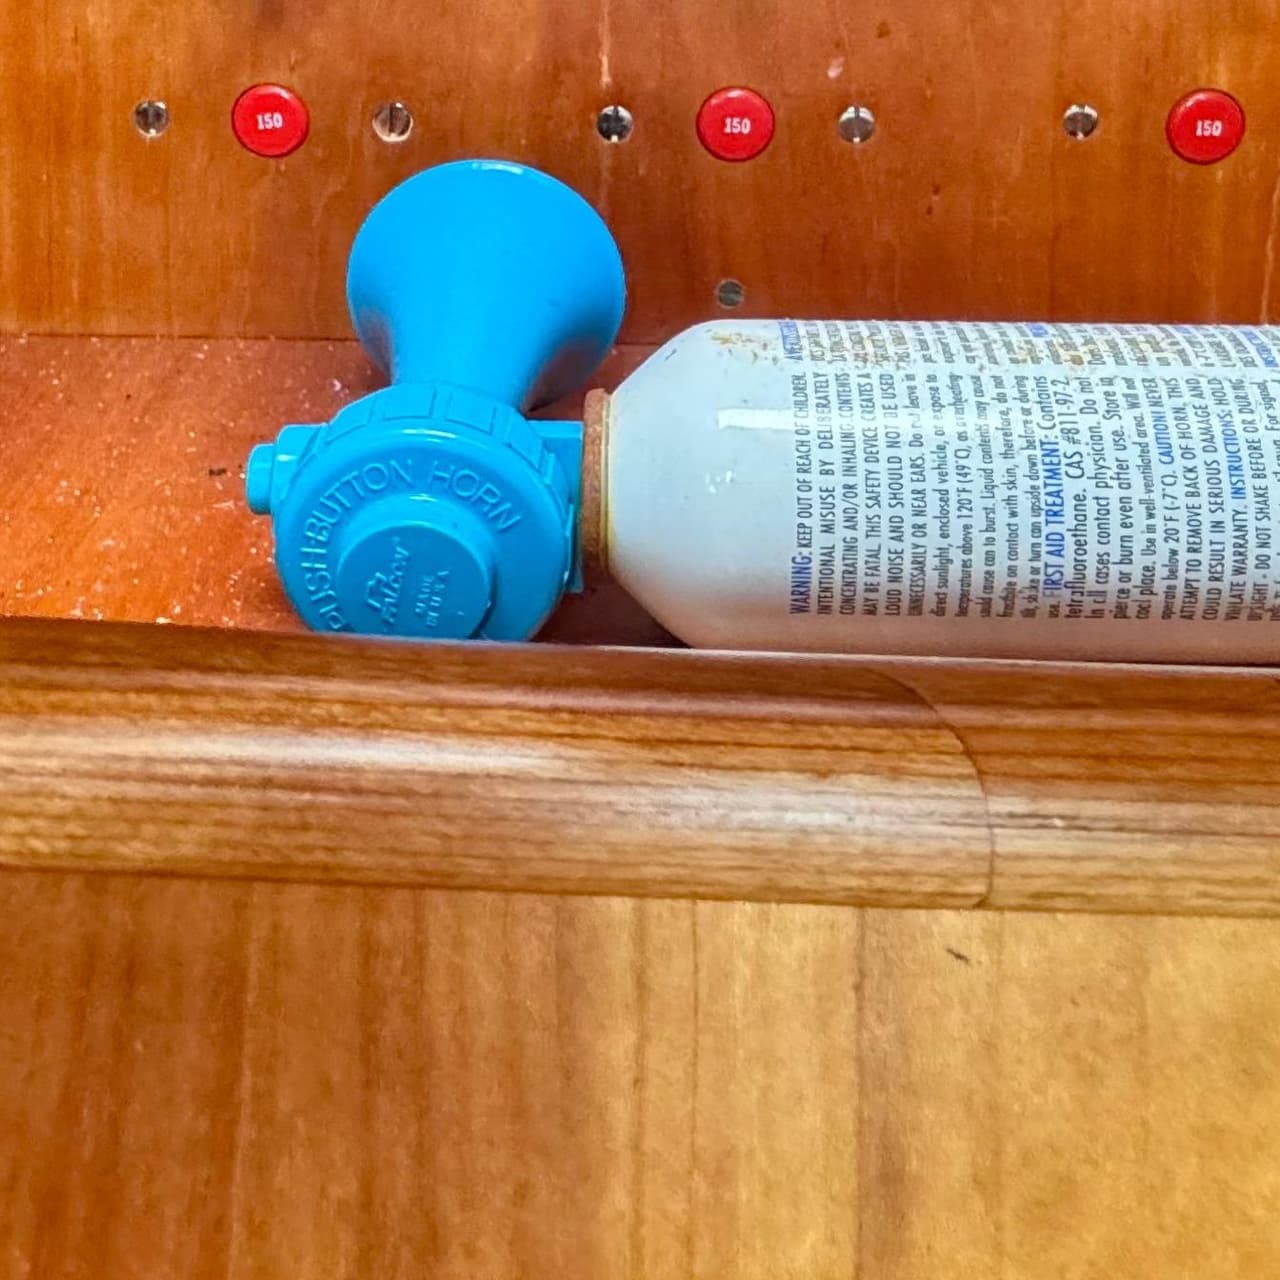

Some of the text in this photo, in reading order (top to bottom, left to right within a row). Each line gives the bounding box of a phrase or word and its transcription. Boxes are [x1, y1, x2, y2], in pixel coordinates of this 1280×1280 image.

[257, 112, 283, 131] 150
[724, 117, 751, 135] 150
[1195, 120, 1223, 137] 150
[856, 372, 872, 380] A
[1072, 376, 1095, 393] not
[1165, 377, 1183, 400] THIS
[1079, 398, 1099, 415] Do
[1141, 377, 1166, 408] NEVER
[794, 421, 810, 435] OF
[908, 433, 924, 448] Do
[1150, 410, 1175, 465] CAUTION!
[795, 440, 811, 473] REACH
[839, 424, 857, 477] INHALING
[862, 427, 880, 463] DEVICE
[1085, 419, 1115, 489] physician.
[1178, 443, 1197, 461] OF
[909, 453, 926, 483] EARS.
[930, 441, 950, 484] vehicle,
[1000, 464, 1019, 491] skin,
[1022, 453, 1041, 481] down
[1063, 450, 1085, 479] CAS
[1207, 377, 1249, 577] WARRANTY. INSTRUCTIONS: HOLD
[1228, 378, 1272, 570] DO NOT SHAKE BEFORE OR DURING
[429, 460, 523, 533] HORN
[796, 478, 812, 492] OF
[864, 469, 881, 509] SAFETY
[879, 373, 904, 616] LOUD NOISE AND SHOULD NOT USED
[1032, 375, 1065, 598] FIRST AID TREATMENT: Contains
[1101, 390, 1134, 583] or burn even after use. Store
[1182, 465, 1201, 498] BACK
[796, 496, 813, 519] OUT
[842, 483, 860, 531] AND/OR
[911, 489, 927, 517] NEAR
[931, 488, 950, 539] enclosed
[1000, 494, 1018, 519] with
[1185, 377, 1226, 620] COULD RESULT IN SERIOUS DAMAGE AND
[865, 514, 881, 539] THIS
[911, 522, 927, 538] OR
[976, 467, 999, 567] can to burst. Liquid
[1030, 521, 1042, 539] can
[1092, 495, 1111, 546] contact
[1140, 523, 1157, 535] in
[1185, 502, 1202, 553] REMOVE
[796, 522, 812, 548] KEEP
[817, 459, 835, 615] INTENTIONAL MISUSE BY
[955, 523, 973, 556] above
[1005, 522, 1019, 561] contact
[1140, 537, 1157, 557] Use
[1027, 541, 1041, 562] turn
[1185, 557, 1202, 574] TO
[838, 536, 858, 615] CONCENTRATING
[1006, 564, 1018, 578] on
[1095, 551, 1111, 585] cases
[1132, 561, 1159, 596] place.
[789, 552, 813, 615] WARNING:
[863, 581, 880, 592] BE
